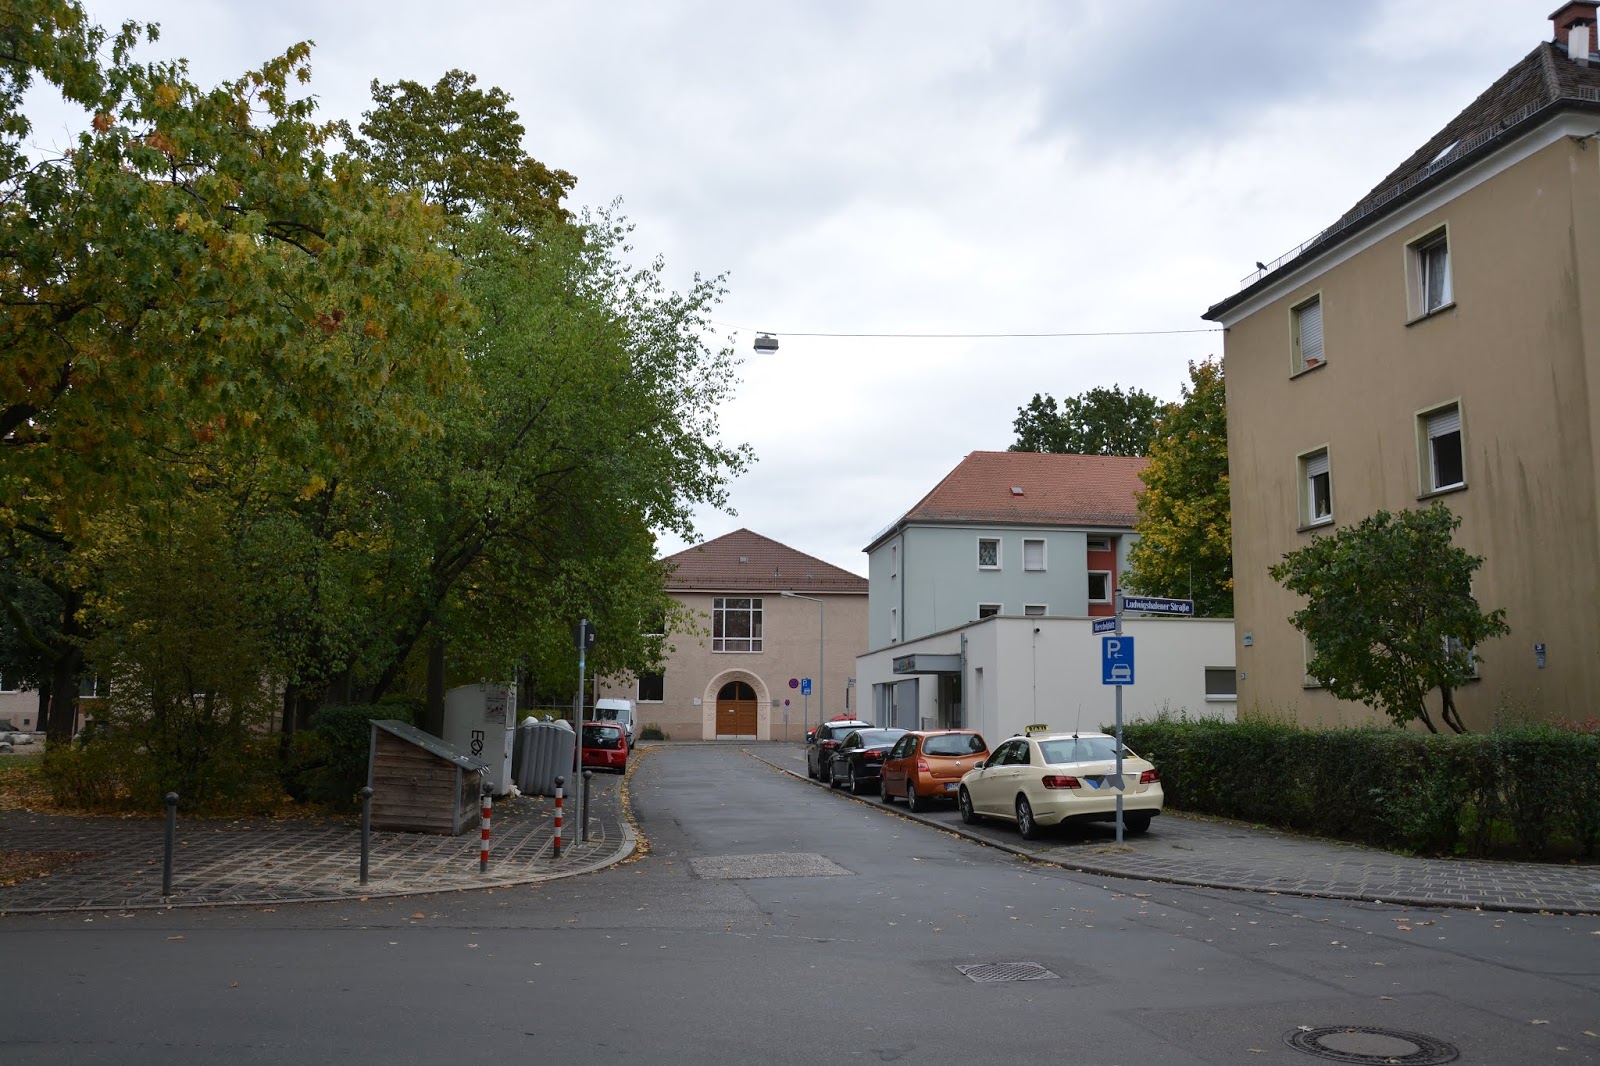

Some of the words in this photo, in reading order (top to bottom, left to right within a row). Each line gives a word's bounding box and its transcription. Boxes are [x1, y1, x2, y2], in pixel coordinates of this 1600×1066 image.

[1125, 599, 1169, 611] Ludwigshafener
[1171, 602, 1190, 613] Straße
[1107, 640, 1121, 659] P
